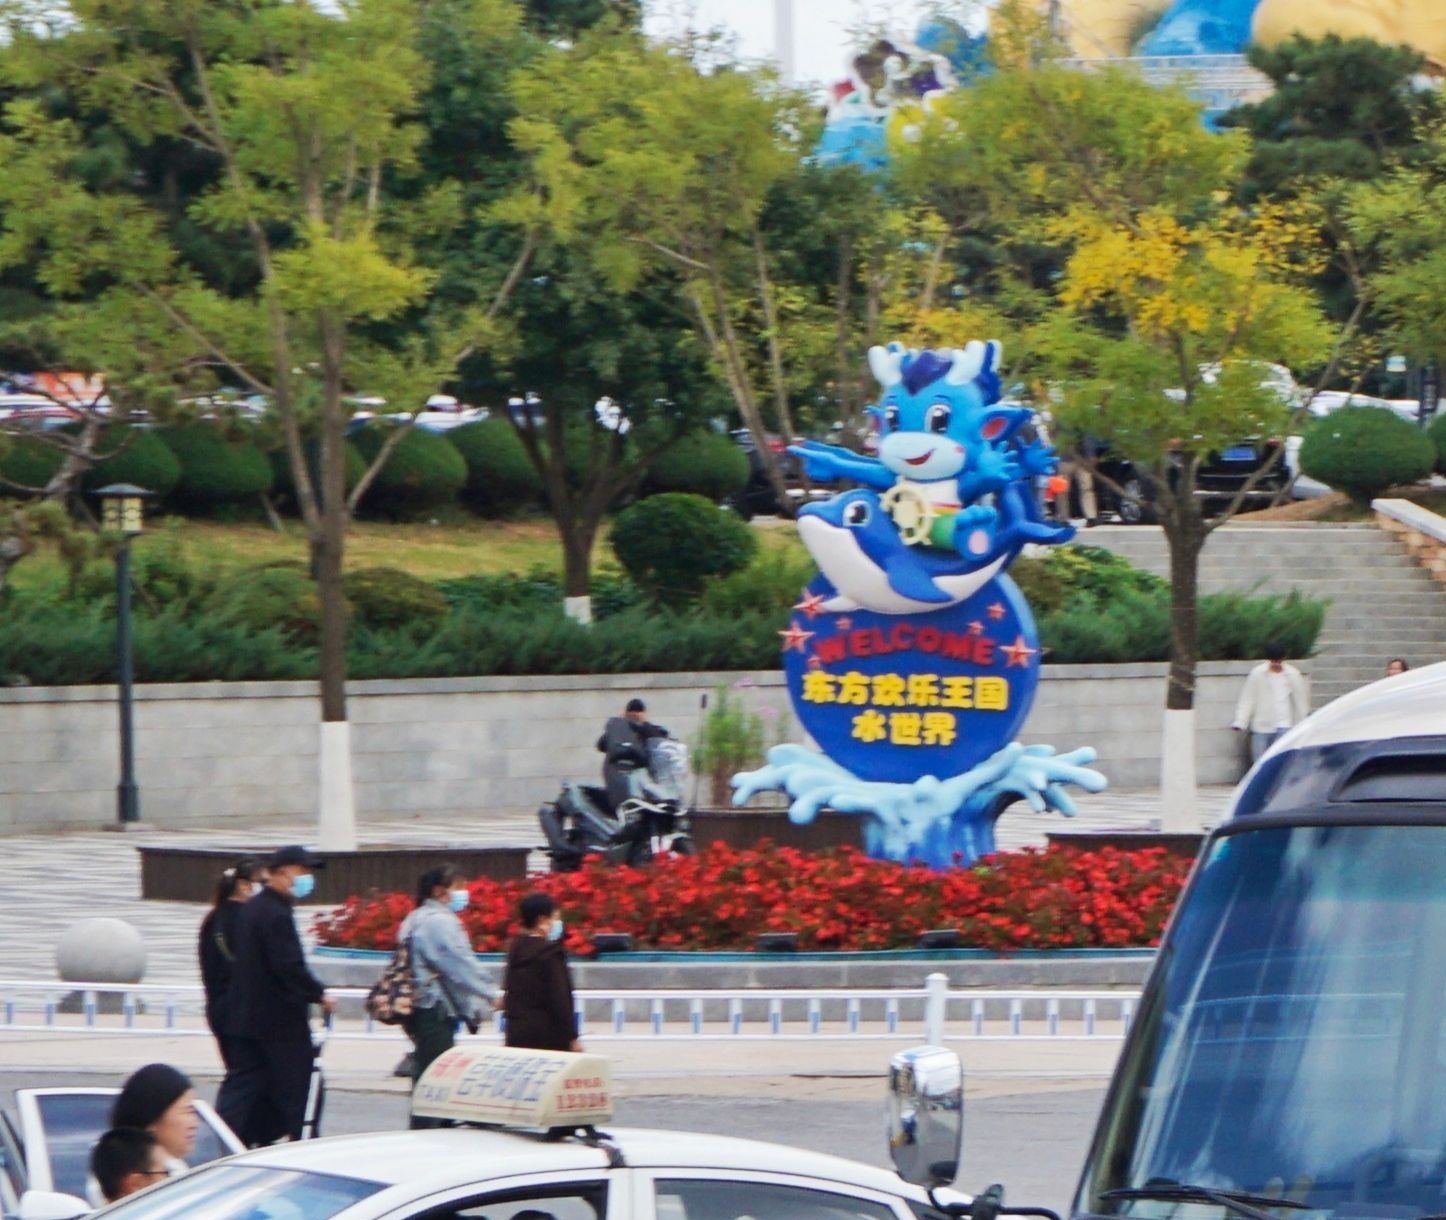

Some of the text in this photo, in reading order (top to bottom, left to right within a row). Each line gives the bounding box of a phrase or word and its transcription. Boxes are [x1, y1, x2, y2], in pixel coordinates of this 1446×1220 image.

[815, 622, 998, 666] WELCOME
[801, 669, 1010, 711] 东方欢乐王国
[851, 708, 958, 746] 水世界
